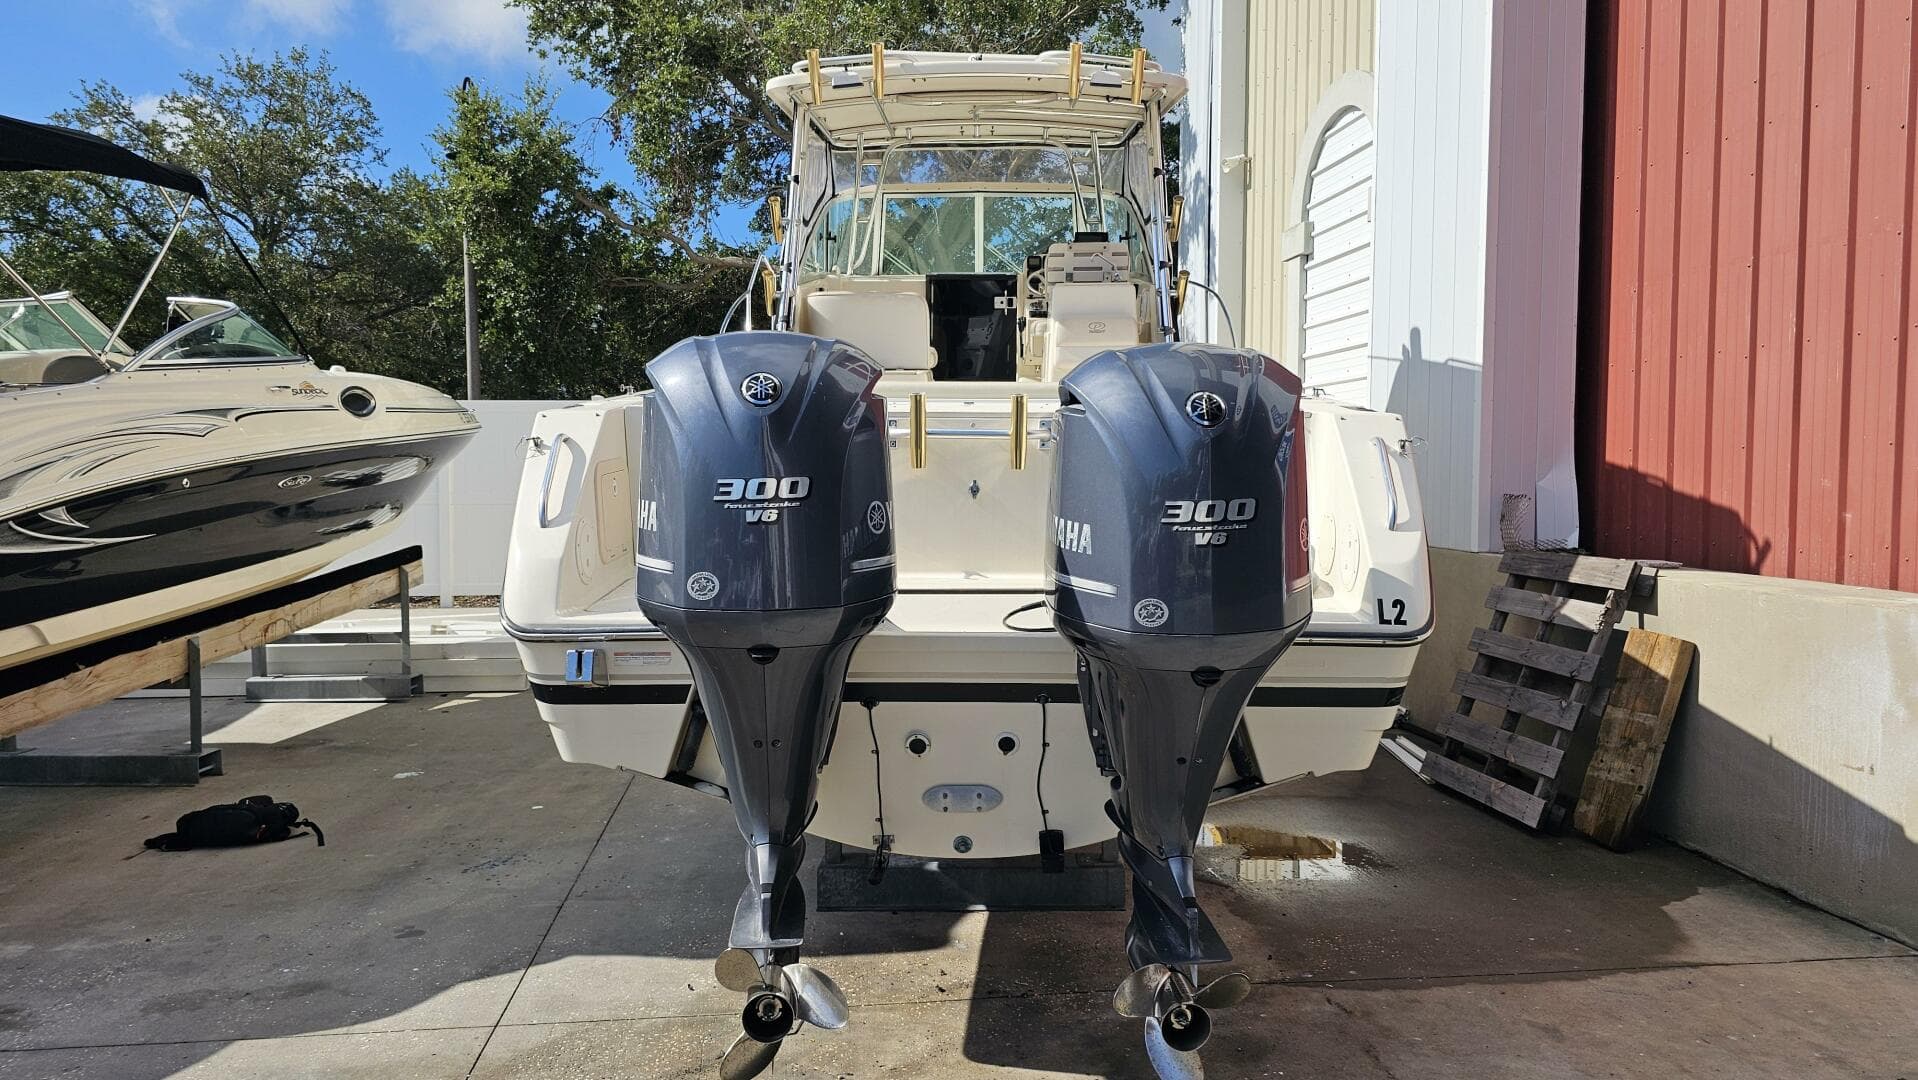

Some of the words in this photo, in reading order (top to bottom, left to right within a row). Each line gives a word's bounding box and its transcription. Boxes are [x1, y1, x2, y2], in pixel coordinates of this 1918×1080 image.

[713, 476, 810, 501] 300
[745, 509, 779, 522] V6
[1160, 498, 1256, 523] 300
[1194, 532, 1228, 545] V6
[1377, 598, 1408, 626] L2
